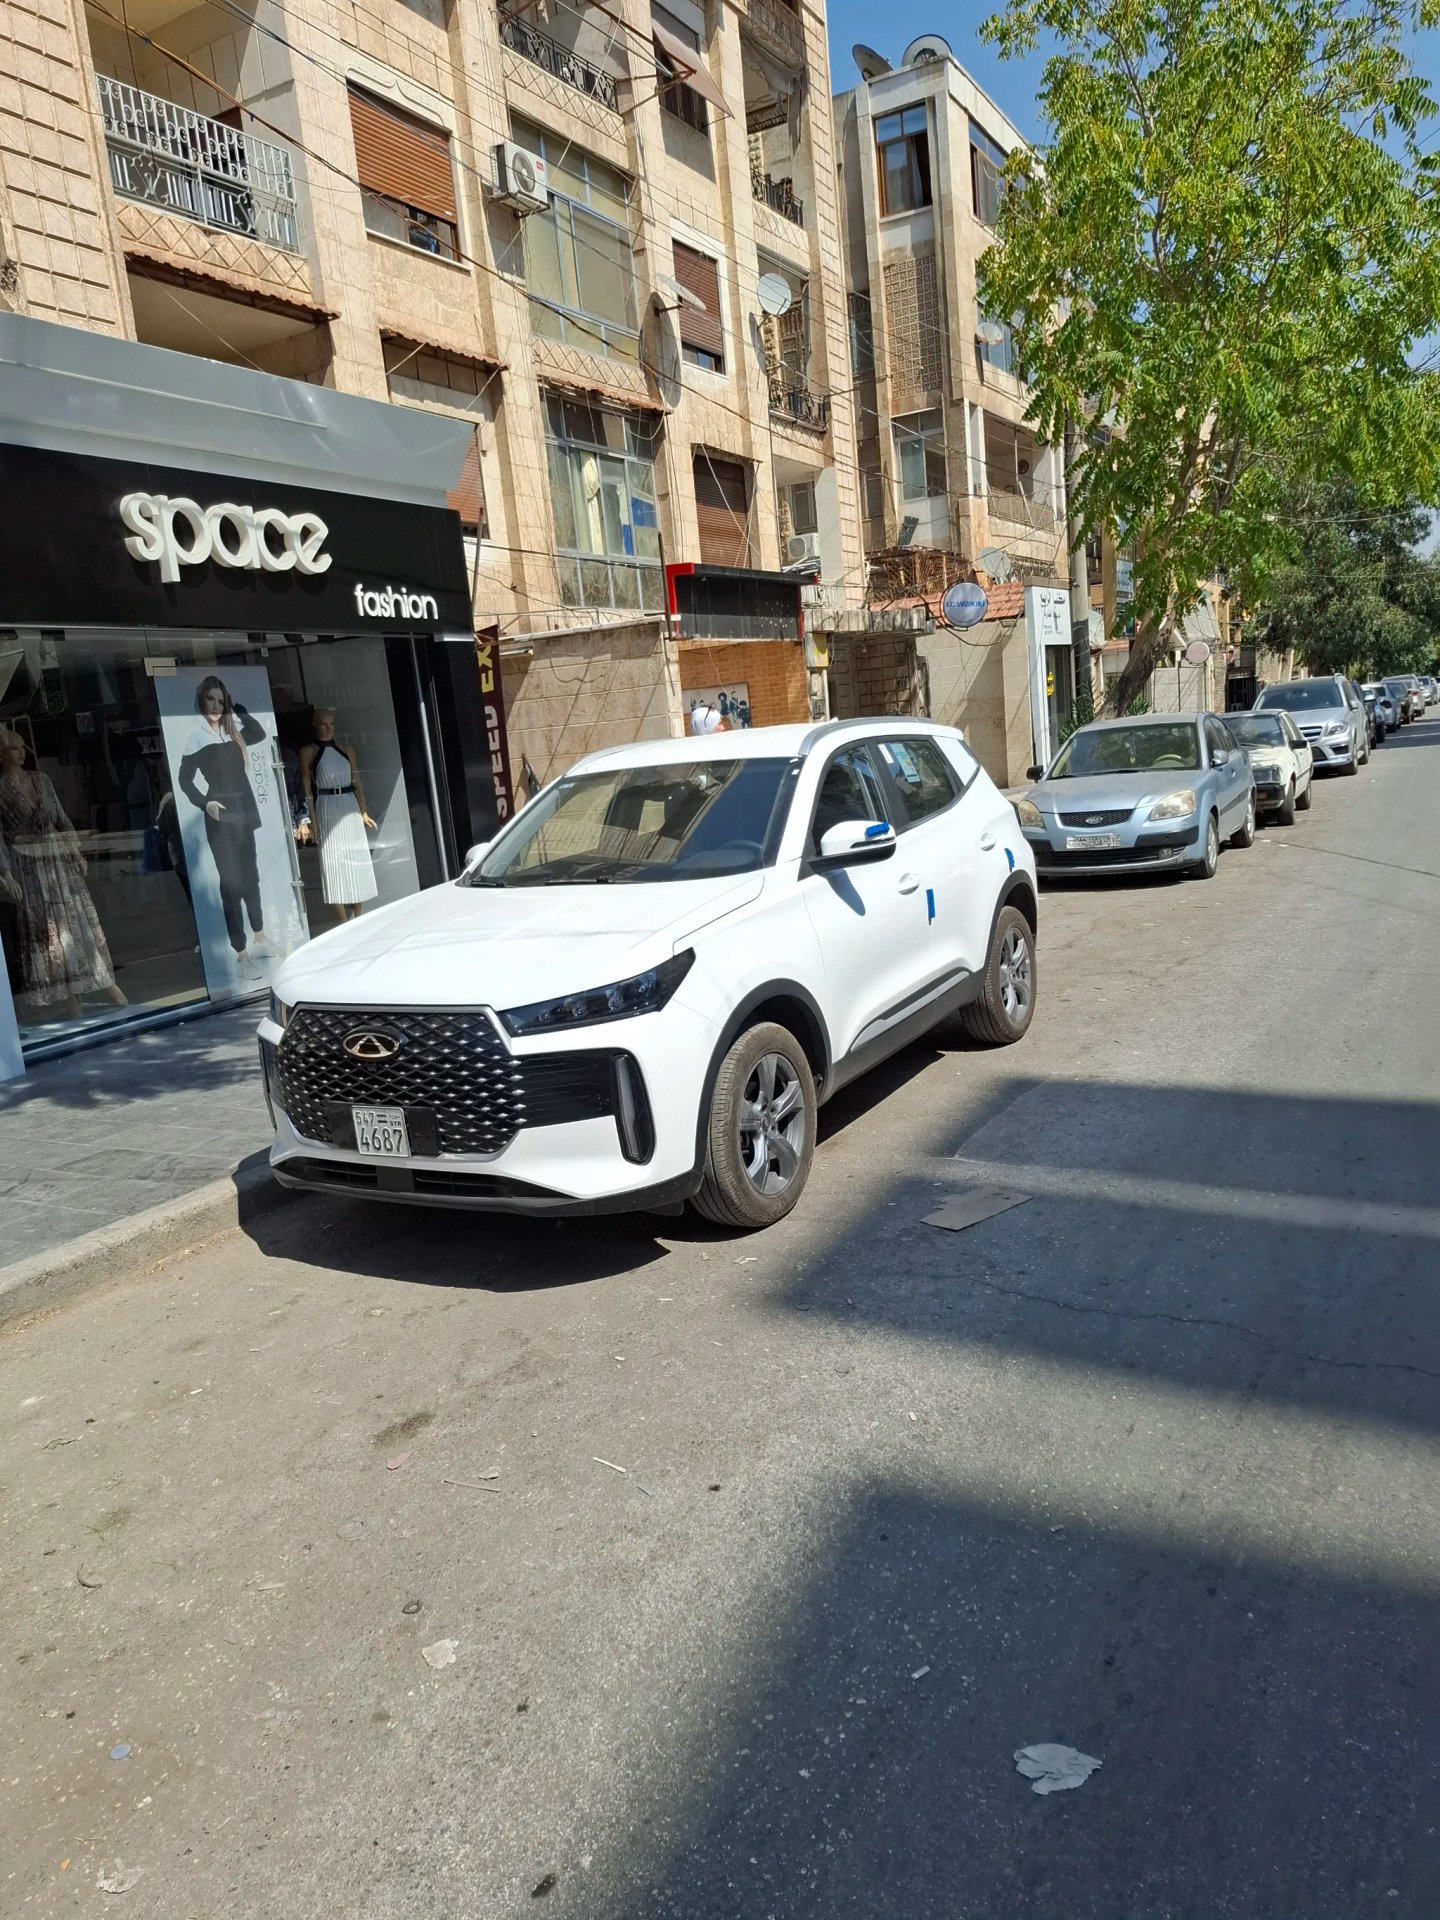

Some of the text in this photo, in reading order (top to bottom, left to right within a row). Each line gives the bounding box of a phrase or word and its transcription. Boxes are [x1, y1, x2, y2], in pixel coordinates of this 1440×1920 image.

[119, 491, 333, 583] space
[353, 583, 439, 621] fashion
[251, 752, 269, 804] space
[484, 705, 508, 818] SPEED
[356, 1112, 375, 1126] 547
[361, 1127, 403, 1152] 4687
